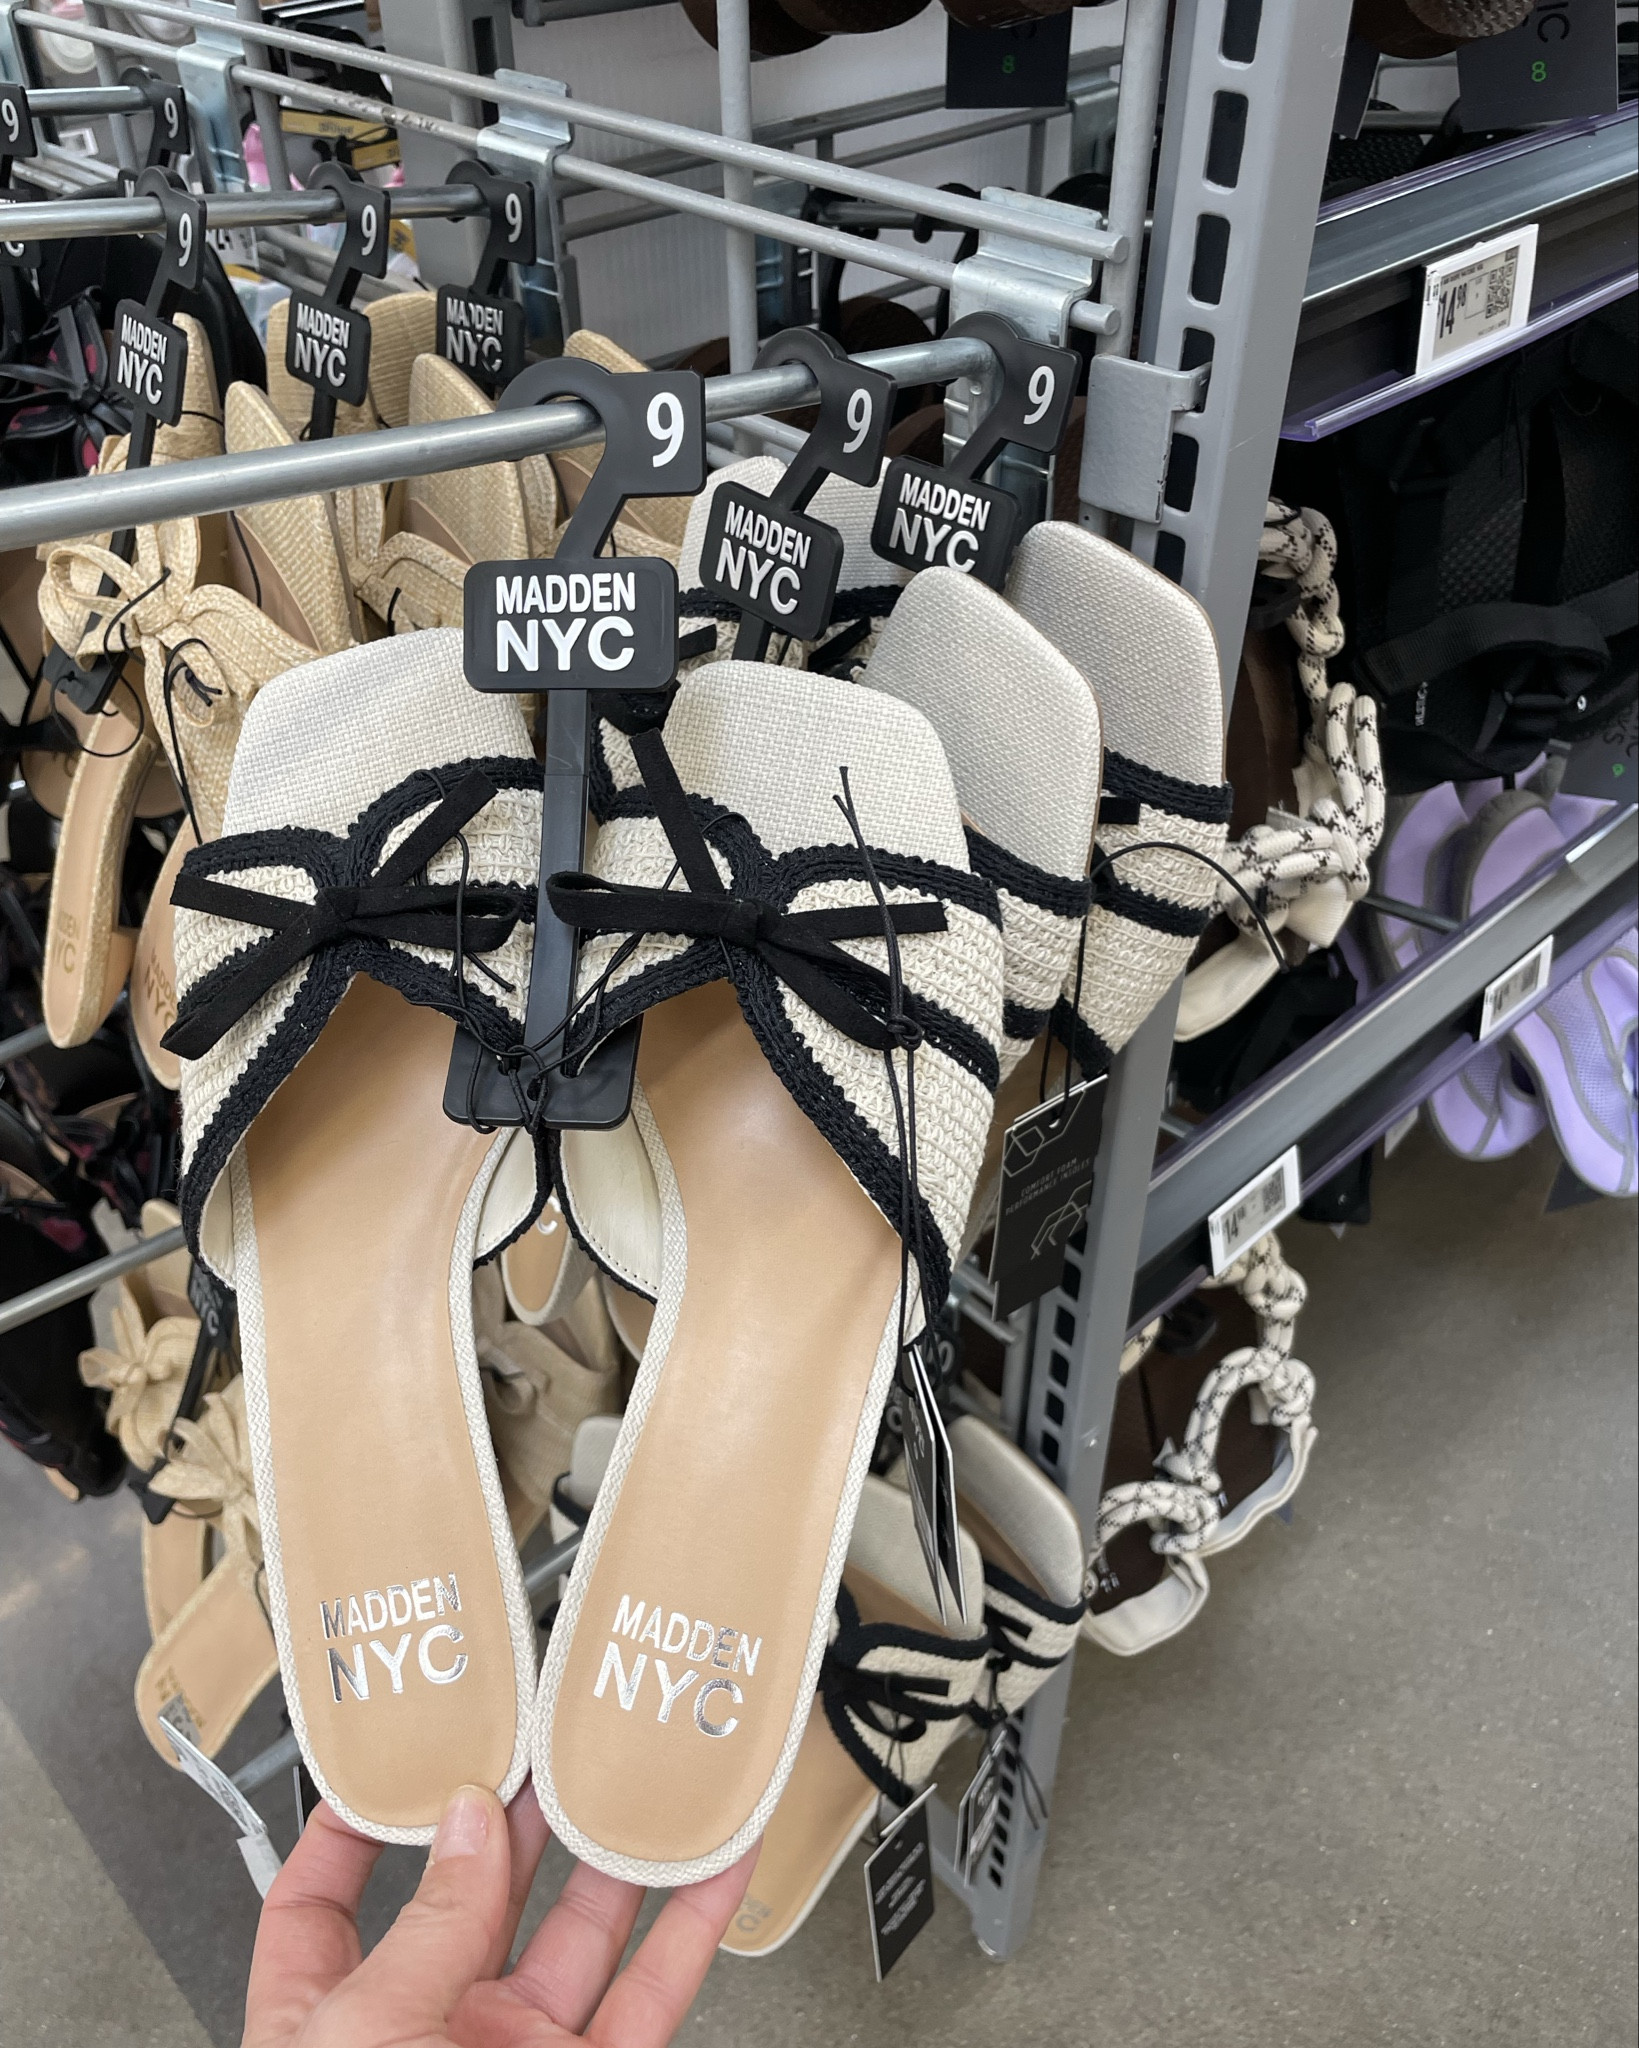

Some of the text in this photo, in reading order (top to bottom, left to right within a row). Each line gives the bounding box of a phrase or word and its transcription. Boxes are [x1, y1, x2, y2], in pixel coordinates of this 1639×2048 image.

[1531, 61, 1547, 82] 8
[2, 98, 19, 142] 9
[164, 97, 179, 138] 9
[178, 212, 192, 267] 9
[362, 204, 377, 256] 9
[505, 193, 522, 243] 9
[121, 313, 167, 365] MADDEN
[297, 302, 350, 349] MADDEN
[446, 326, 502, 372] NYC
[117, 345, 163, 405] NYC
[294, 332, 346, 387] NYC
[842, 388, 873, 453] 9
[1023, 365, 1055, 425] 9
[646, 391, 685, 468] 9
[899, 473, 990, 532] MADDEN
[724, 501, 812, 570] MADDEN
[889, 508, 979, 573] NYC
[496, 571, 636, 615] MADDEN
[715, 537, 801, 615] NYC
[496, 616, 635, 673] NYC
[150, 947, 178, 1012] MADDE
[319, 1572, 462, 1640] MADDEN
[611, 1594, 763, 1676] MADDEN
[327, 1624, 468, 1703] NYC
[593, 1641, 744, 1738] NYC
